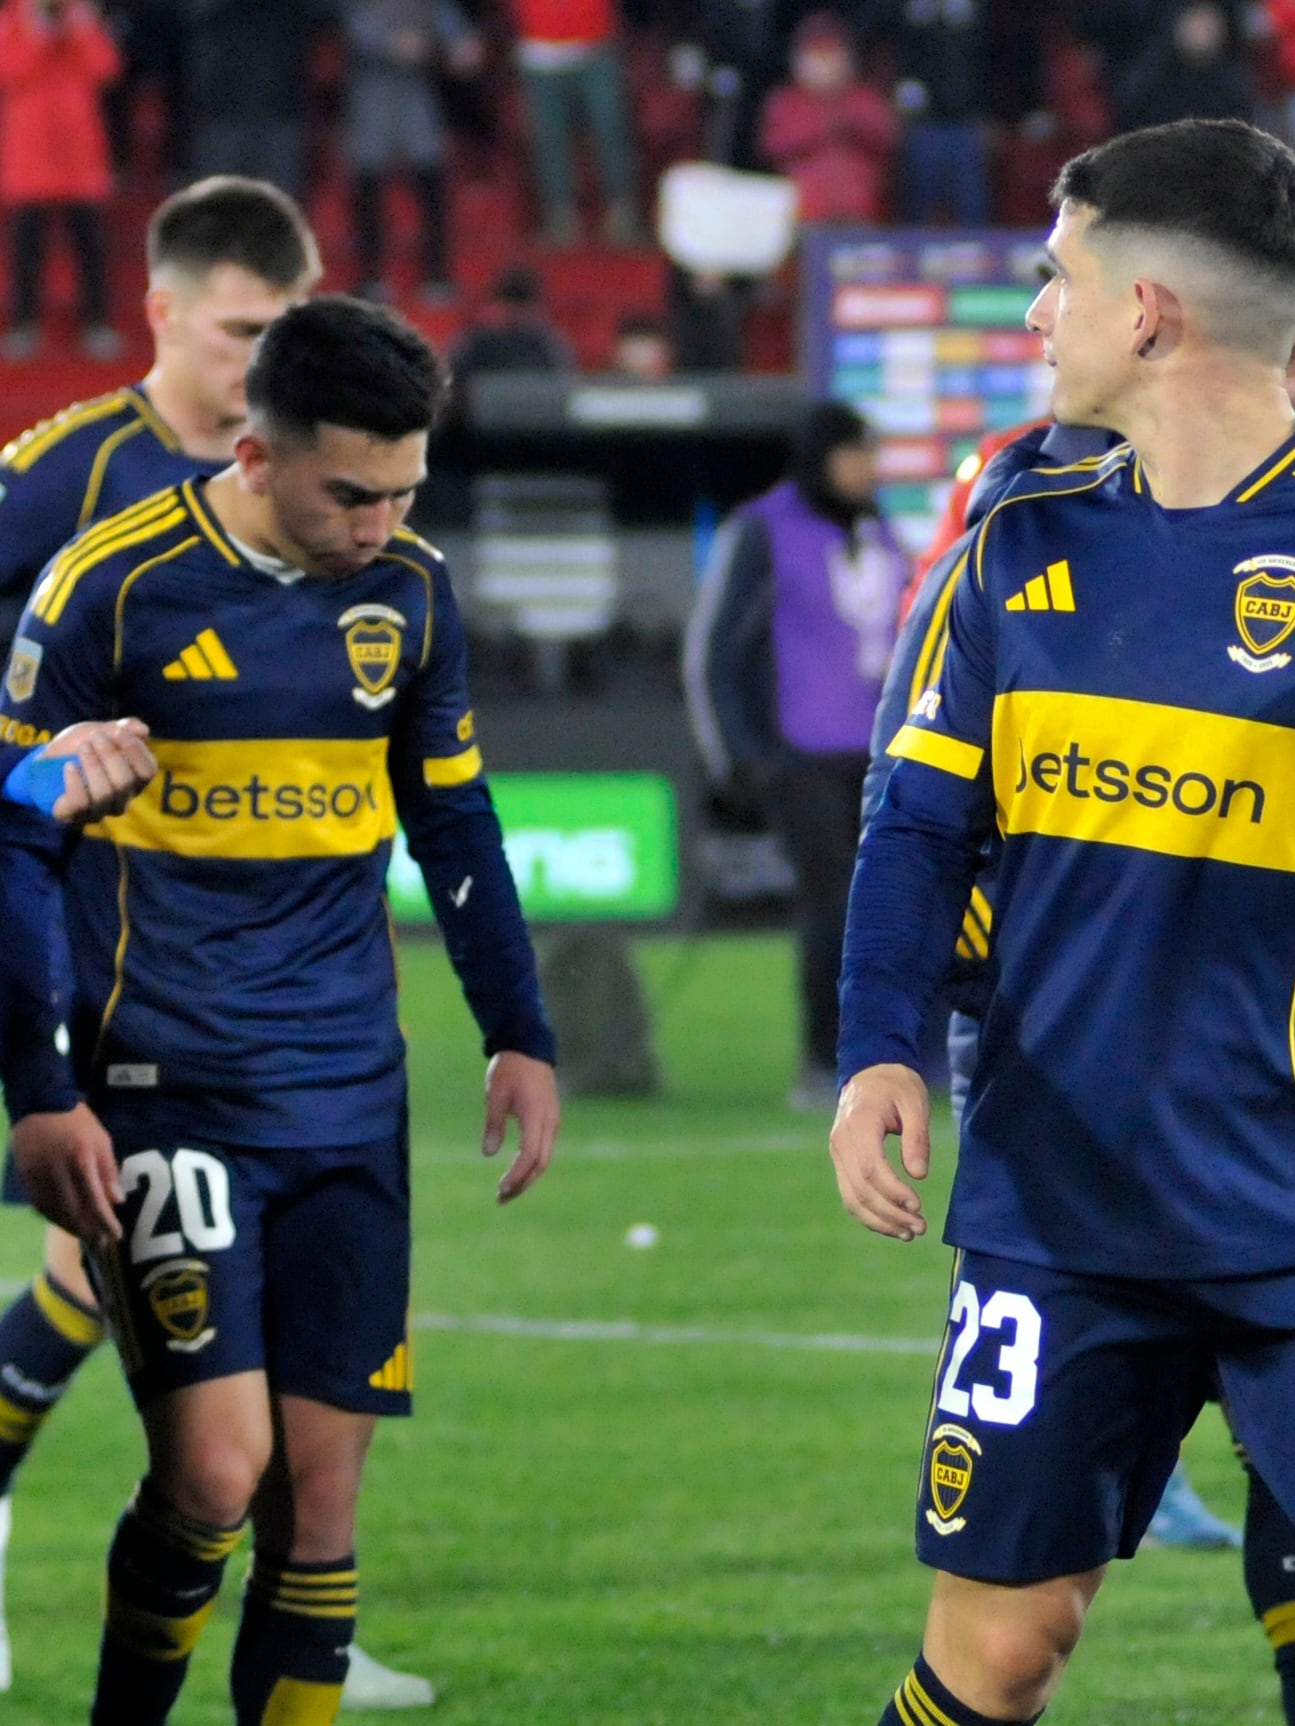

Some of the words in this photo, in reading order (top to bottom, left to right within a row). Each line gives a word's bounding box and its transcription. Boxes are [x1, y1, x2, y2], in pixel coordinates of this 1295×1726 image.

[1245, 600, 1293, 618] CABJ
[121, 1149, 237, 1264] 20
[937, 1279, 1042, 1426] 23
[936, 1467, 965, 1486] CABJ
